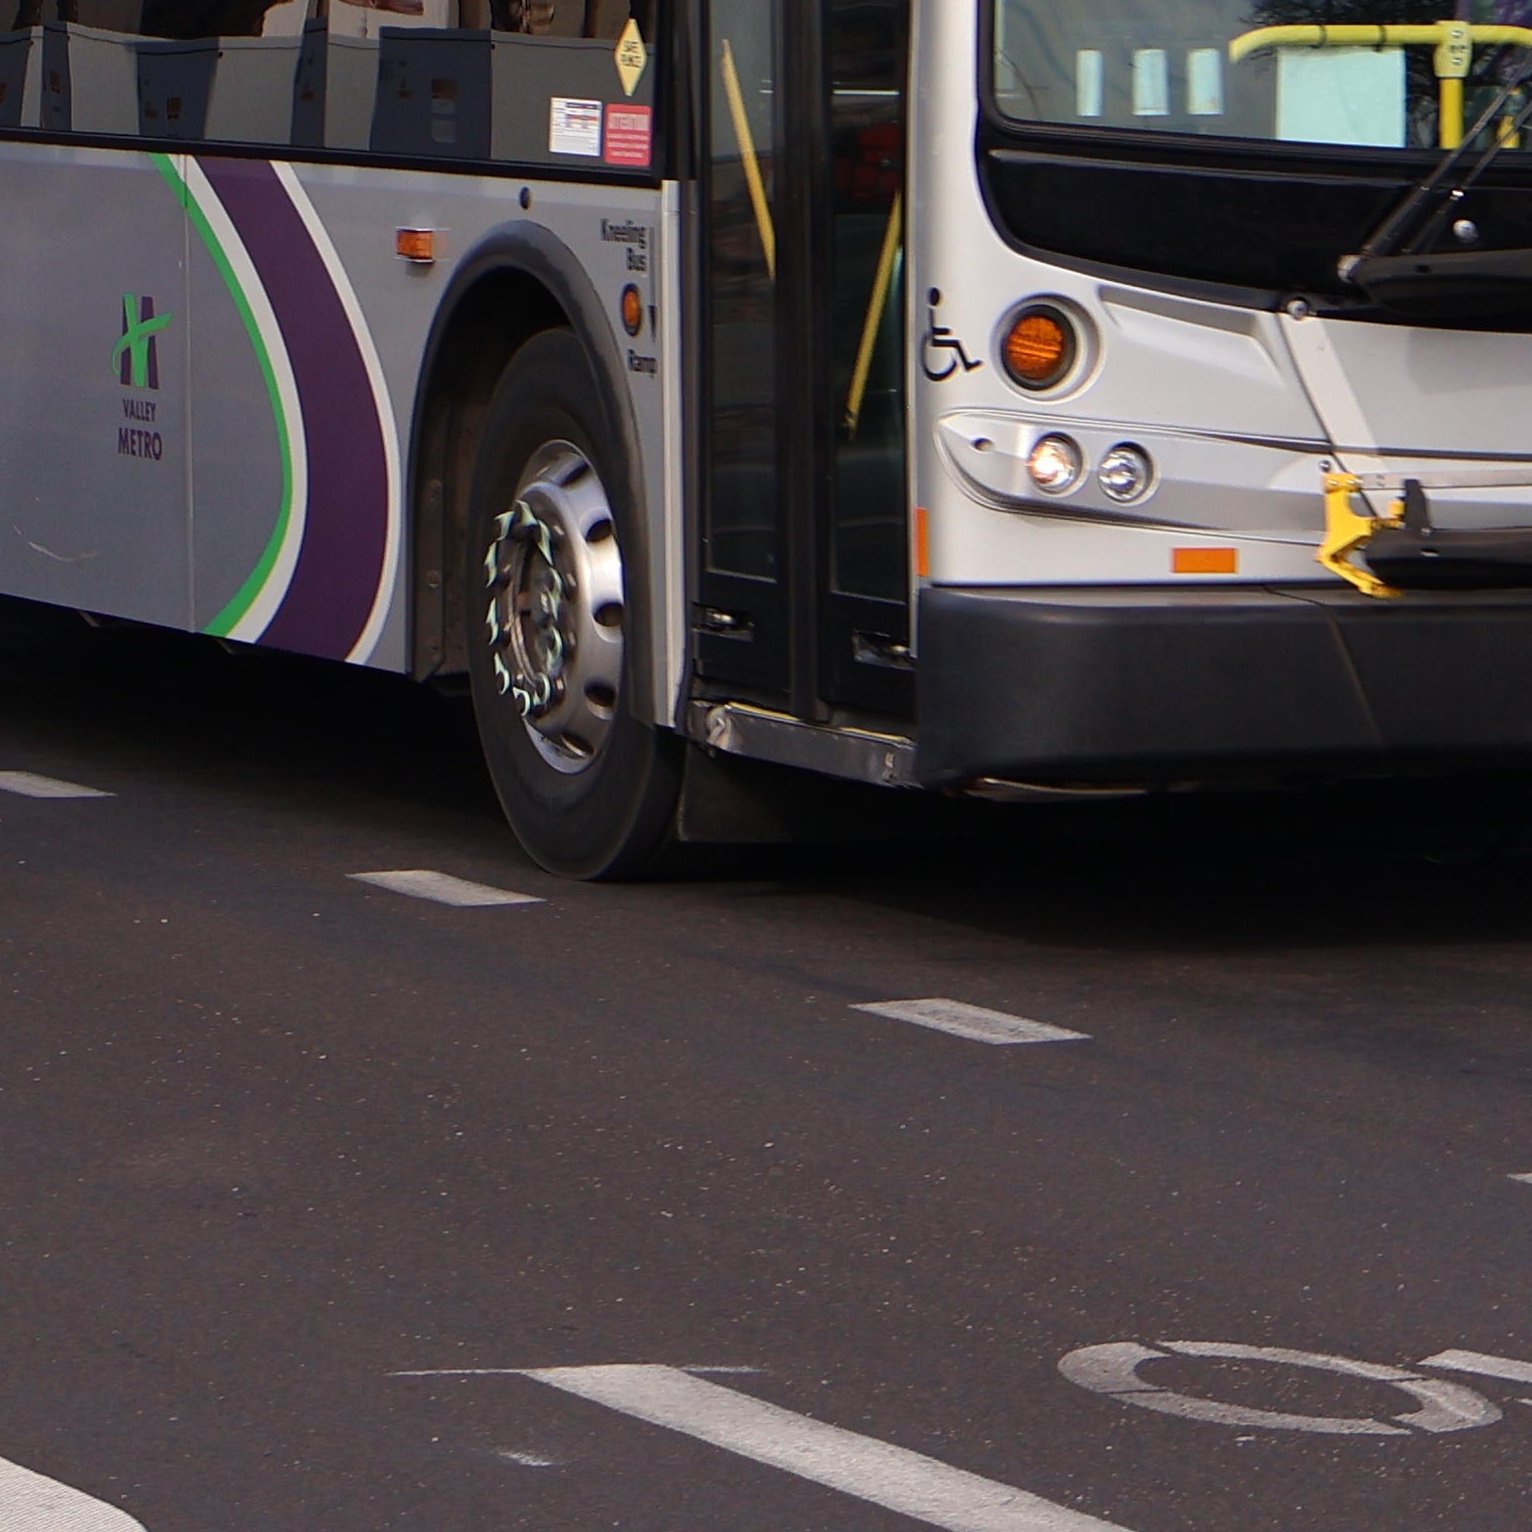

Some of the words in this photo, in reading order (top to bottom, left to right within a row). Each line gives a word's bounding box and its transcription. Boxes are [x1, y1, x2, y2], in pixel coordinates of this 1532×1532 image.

[599, 218, 646, 249] Kneeling
[627, 247, 647, 272] Bus
[627, 349, 657, 379] Ramp
[122, 398, 157, 421] VALLEY
[118, 427, 163, 461] METRO
